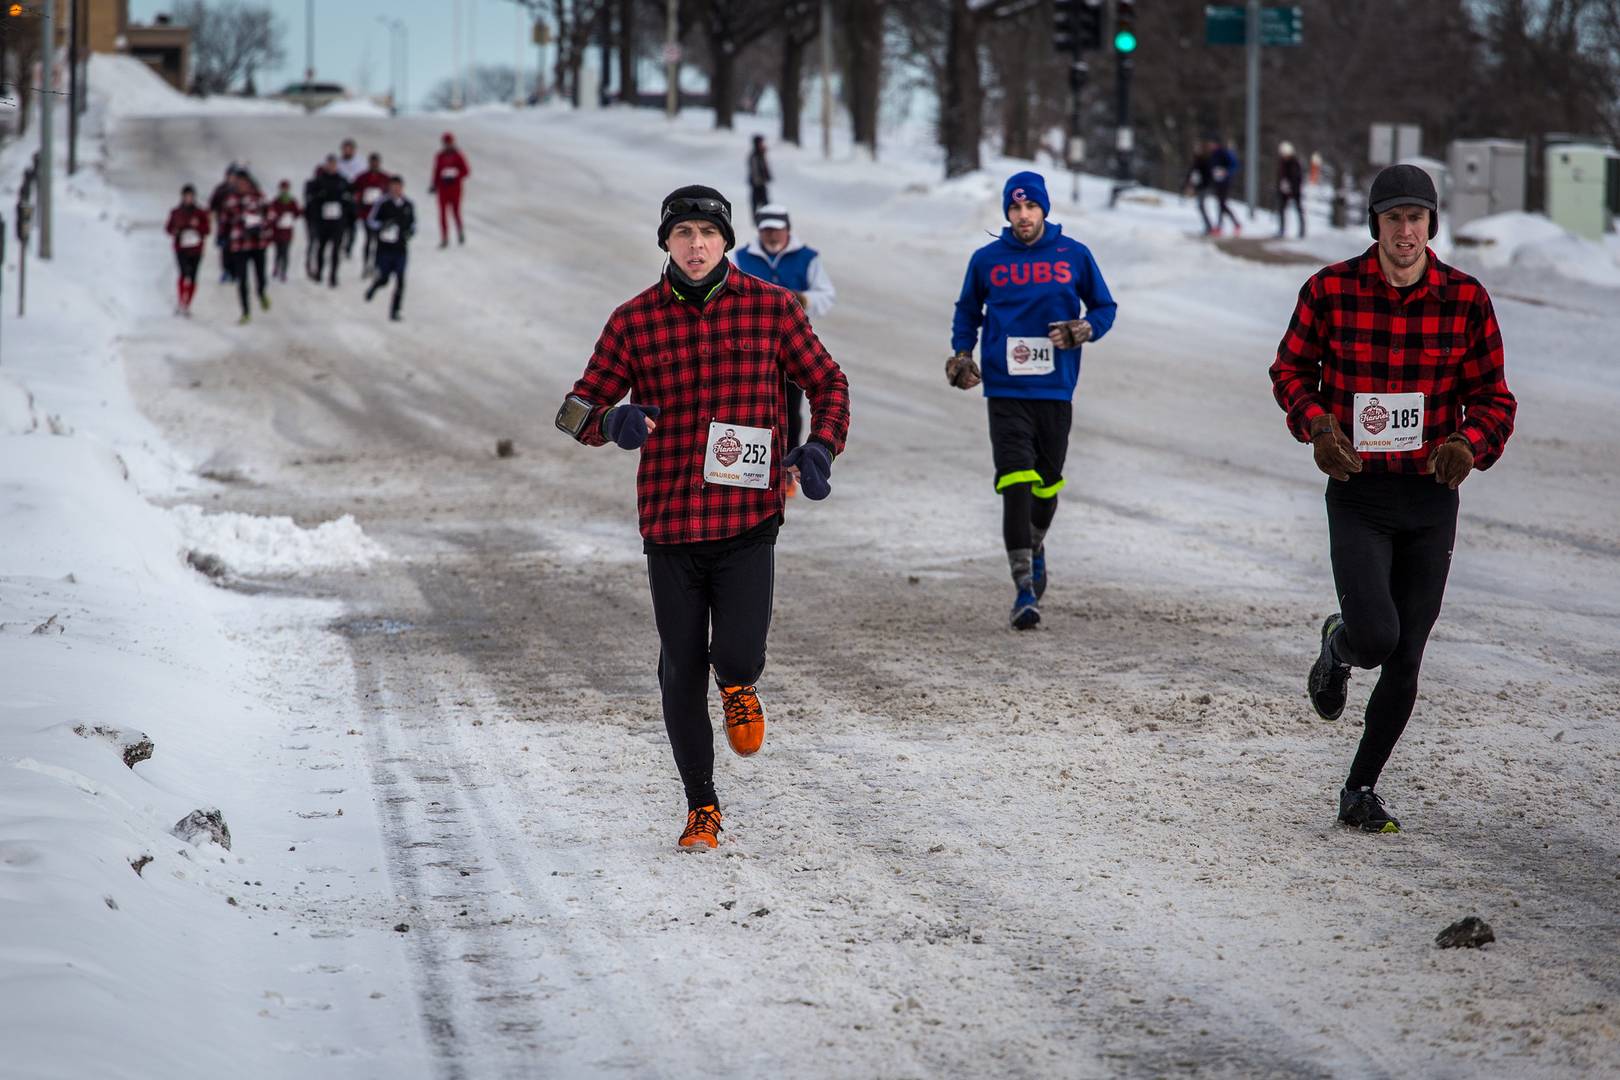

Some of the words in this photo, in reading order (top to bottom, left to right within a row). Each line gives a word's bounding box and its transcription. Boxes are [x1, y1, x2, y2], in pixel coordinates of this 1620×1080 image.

[990, 261, 1072, 287] CUBS
[1032, 348, 1050, 361] 341
[1392, 408, 1419, 428] 185
[742, 444, 767, 464] 252
